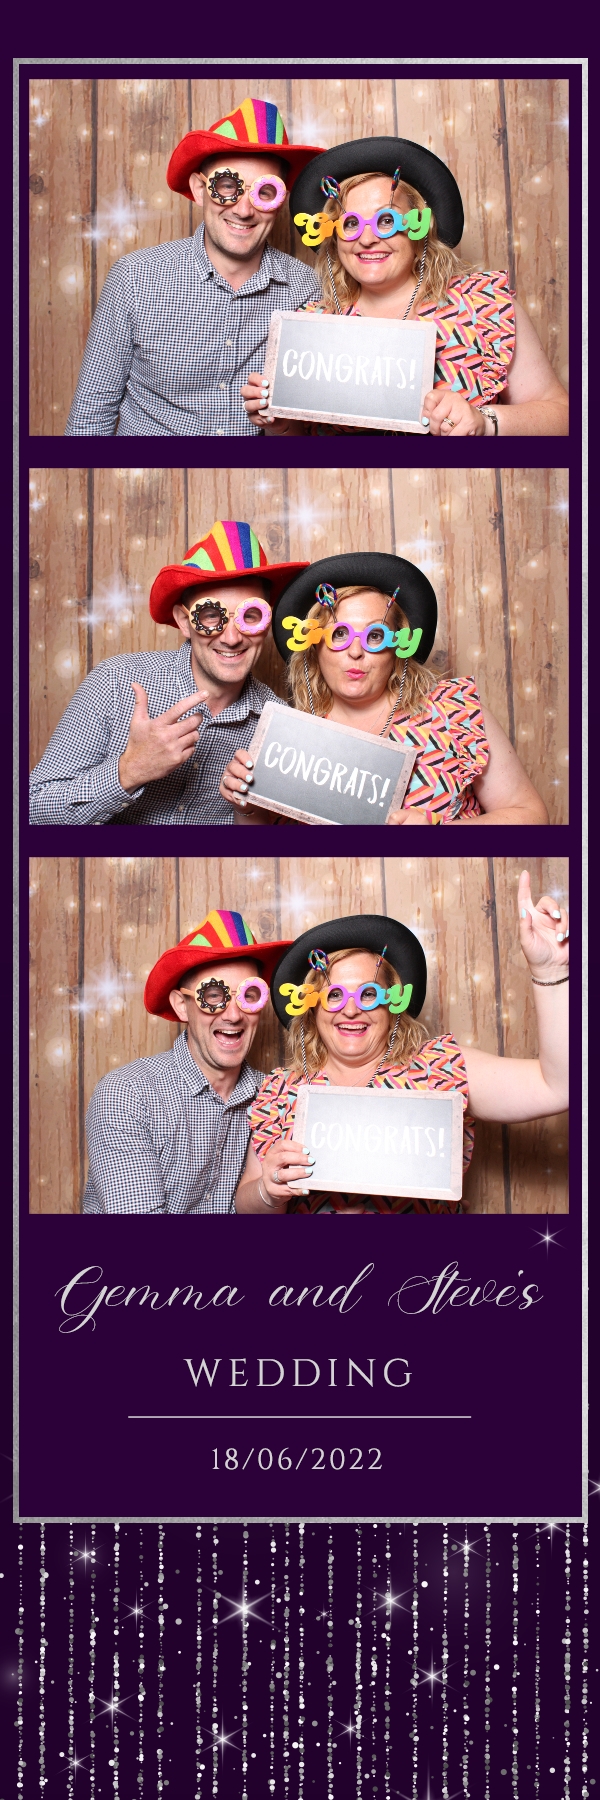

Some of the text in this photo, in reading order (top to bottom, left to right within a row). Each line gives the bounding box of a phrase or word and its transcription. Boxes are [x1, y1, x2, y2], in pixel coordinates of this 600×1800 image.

[282, 348, 416, 390] CONGRATS!
[264, 741, 391, 807] CONGRATS!
[310, 1121, 445, 1158] CONGRATS!
